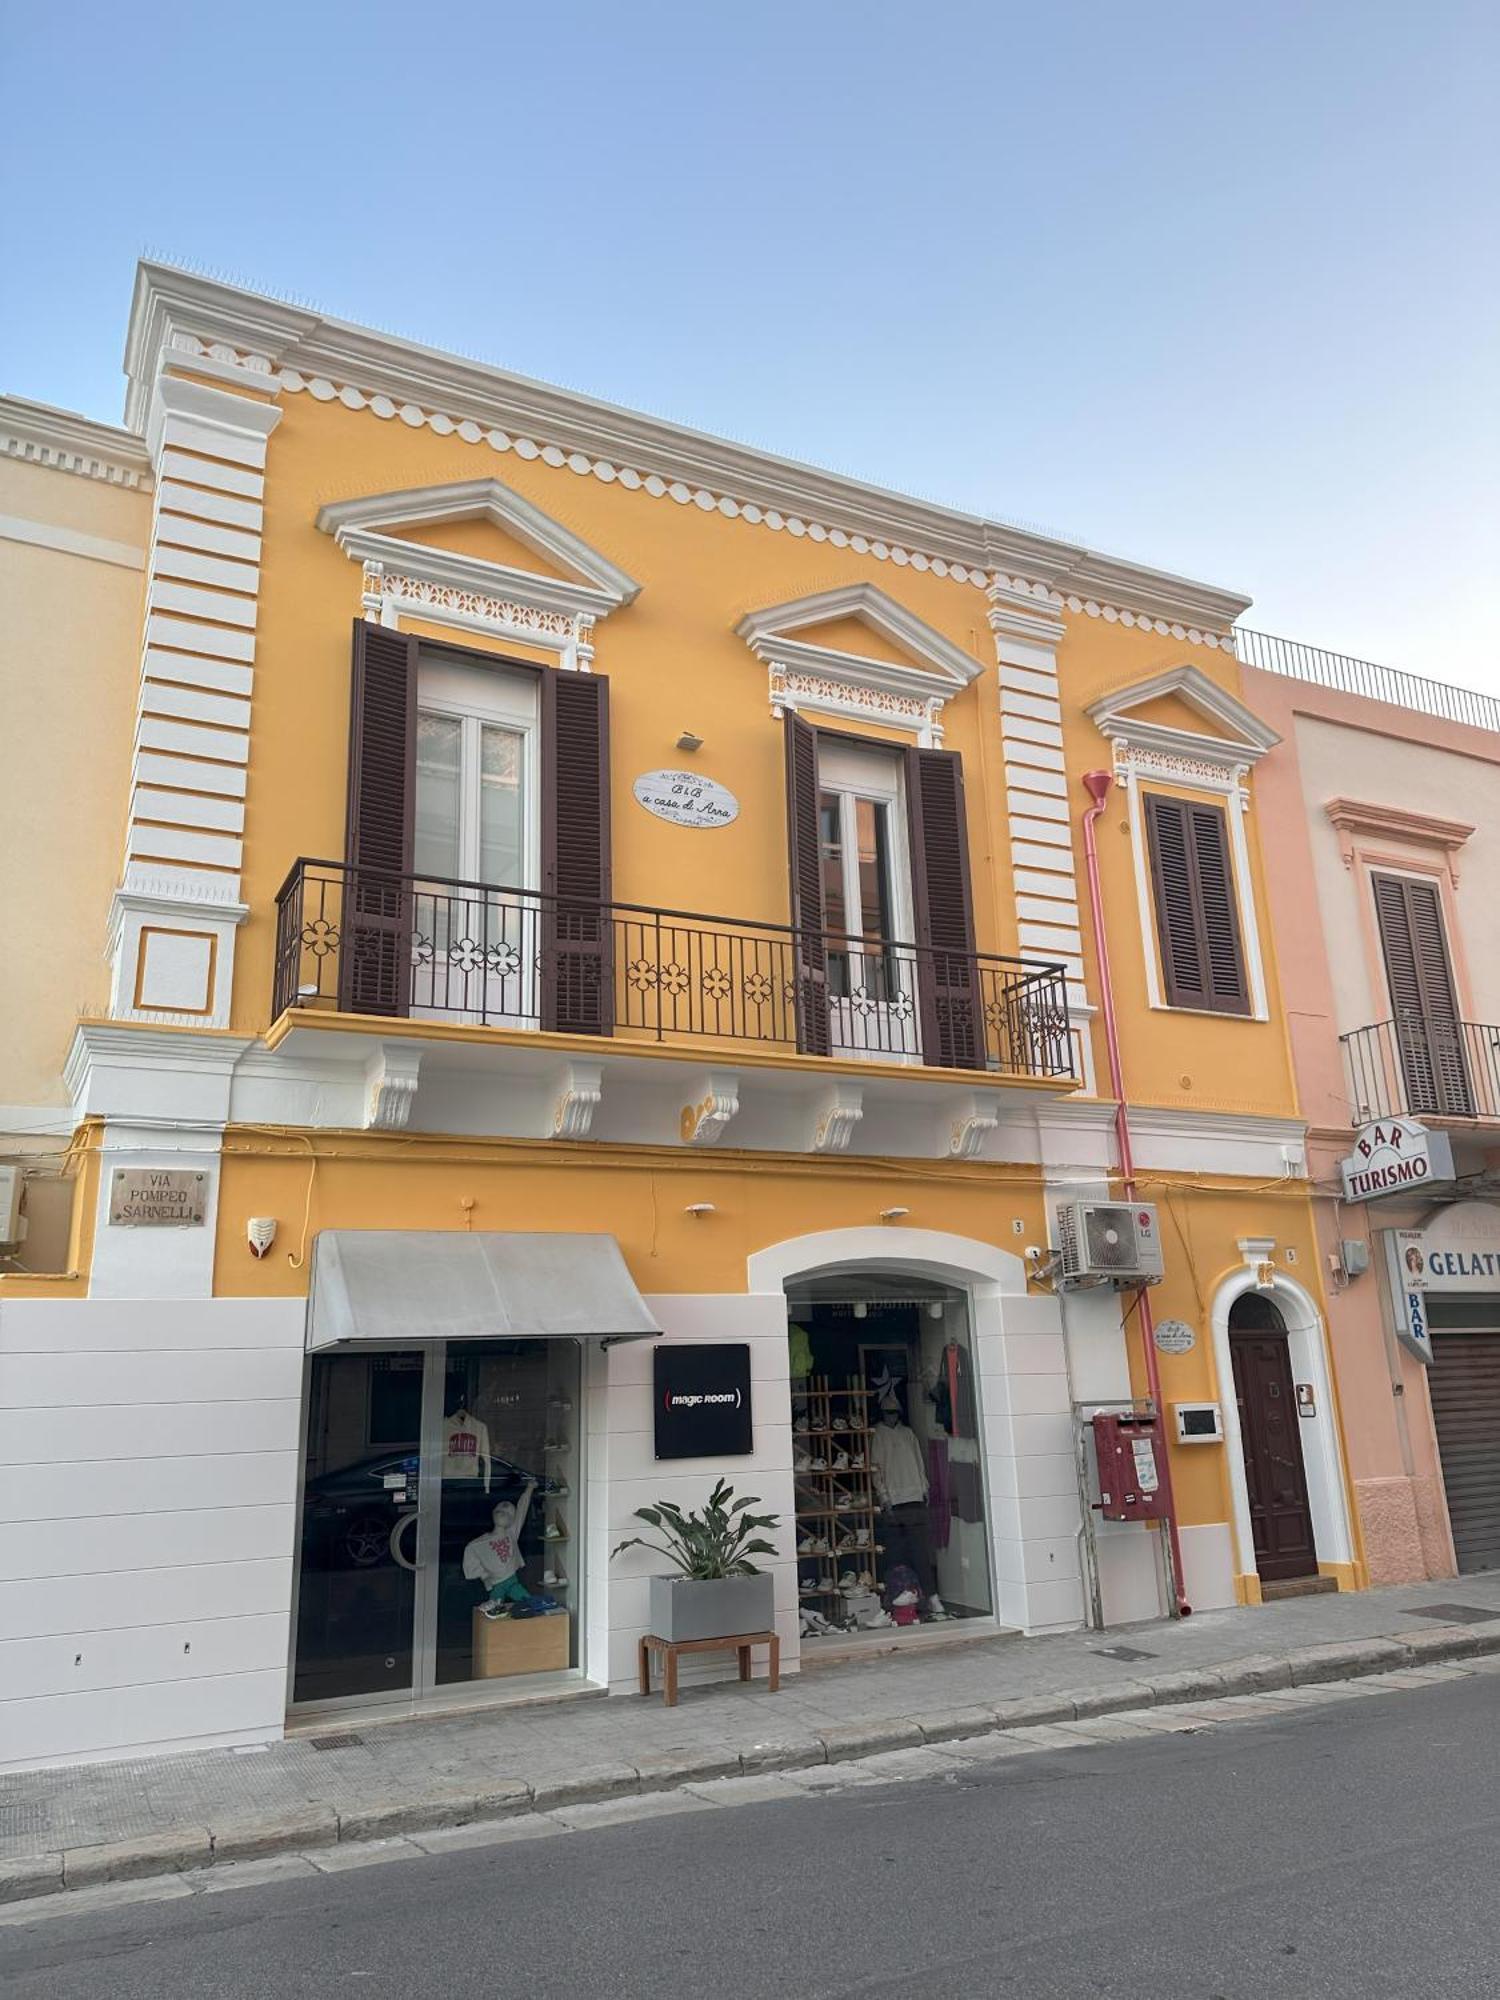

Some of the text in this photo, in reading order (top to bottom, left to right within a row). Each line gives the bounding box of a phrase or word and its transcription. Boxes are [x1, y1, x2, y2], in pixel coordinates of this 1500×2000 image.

[654, 798, 680, 809] casa
[682, 799, 694, 811] di
[696, 802, 731, 818] Anna
[1358, 1125, 1402, 1159] BAR
[150, 1175, 171, 1187] VIA
[1348, 1157, 1428, 1196] TURISMO
[130, 1190, 187, 1203] POMPEO
[122, 1204, 193, 1220] SARNELLI
[1140, 1229, 1151, 1238] LG
[1408, 1294, 1425, 1338] BAR
